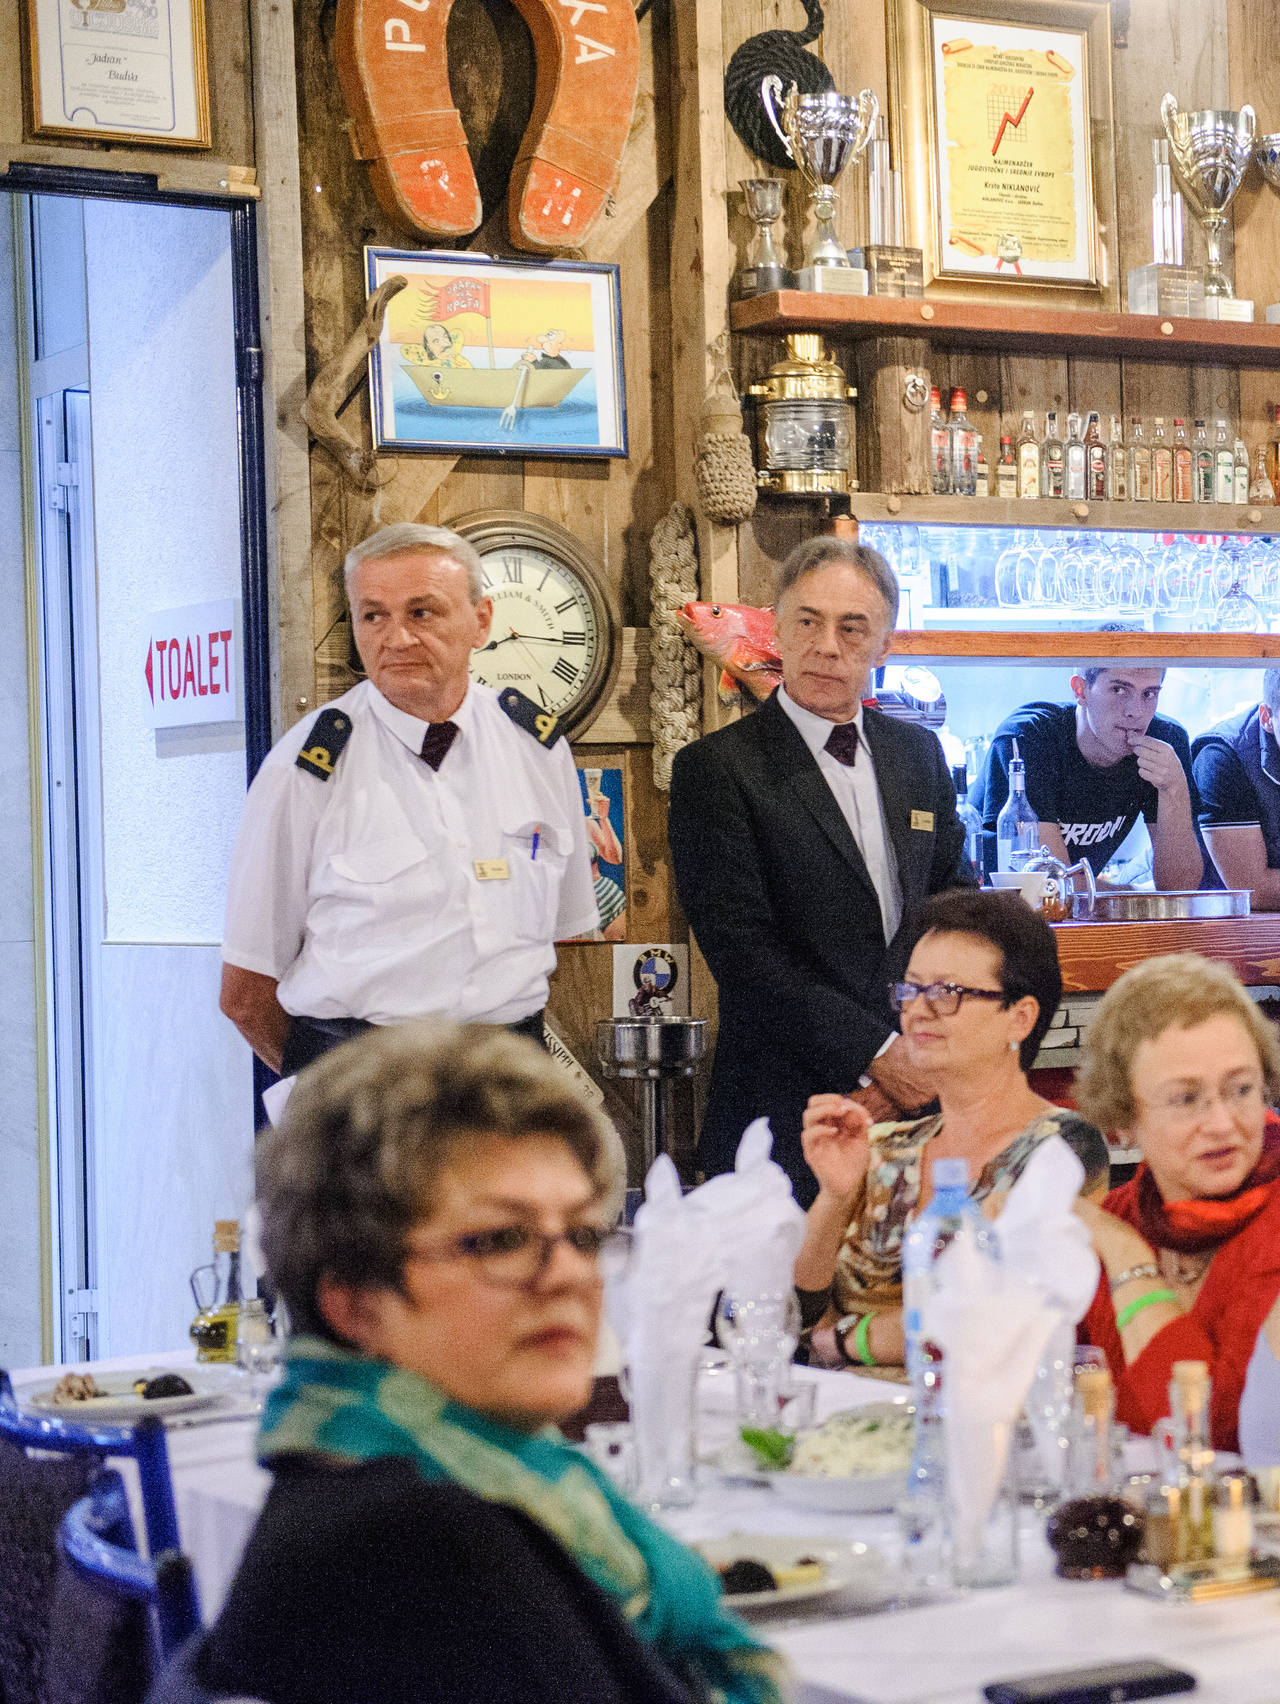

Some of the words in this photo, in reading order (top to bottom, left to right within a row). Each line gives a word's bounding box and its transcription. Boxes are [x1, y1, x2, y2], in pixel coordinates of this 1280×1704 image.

[108, 70, 139, 82] Budva
[993, 159, 1033, 168] NAJMENADŽER
[968, 165, 1004, 174] JUGOISTOČNE
[1010, 169, 1033, 177] SREDNJE
[1034, 170, 1055, 178] EVROPE
[984, 182, 1000, 190] Krsto
[1002, 182, 1040, 193] NIKLANOVIĆ
[155, 629, 232, 701] TOALET
[639, 949, 674, 964] BMW
